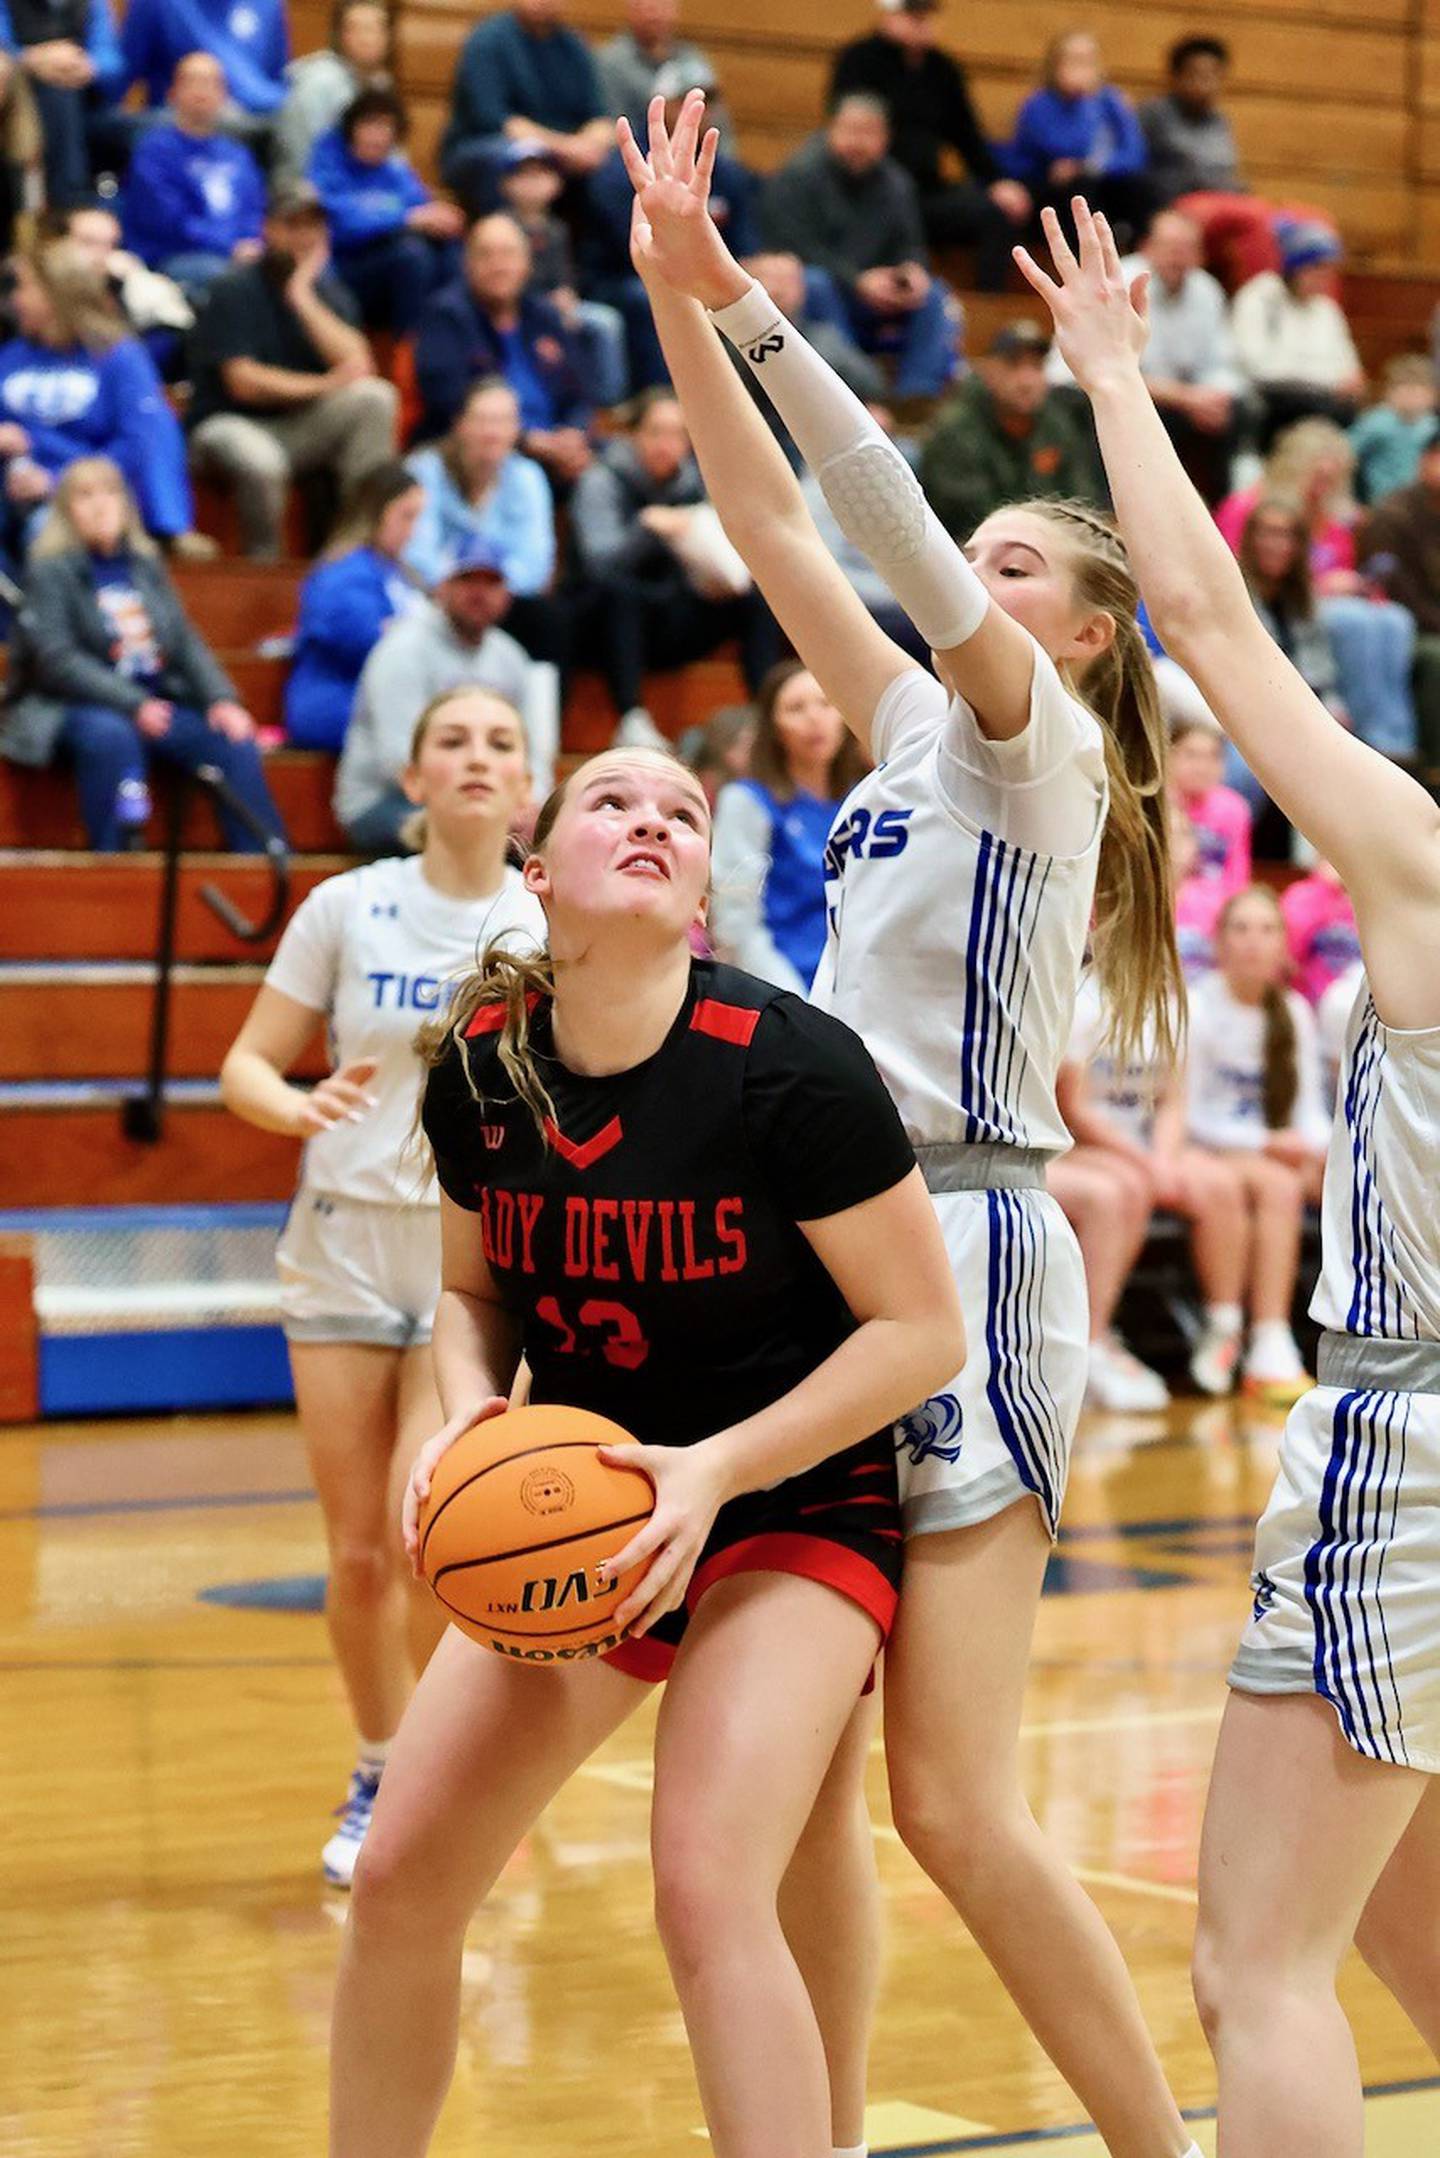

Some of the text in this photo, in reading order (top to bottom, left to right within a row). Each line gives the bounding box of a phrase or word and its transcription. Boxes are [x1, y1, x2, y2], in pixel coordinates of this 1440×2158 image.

[368, 973, 458, 1010] TIG
[476, 1186, 747, 1282] ADY DEVILS
[492, 1627, 631, 1661] ilson
